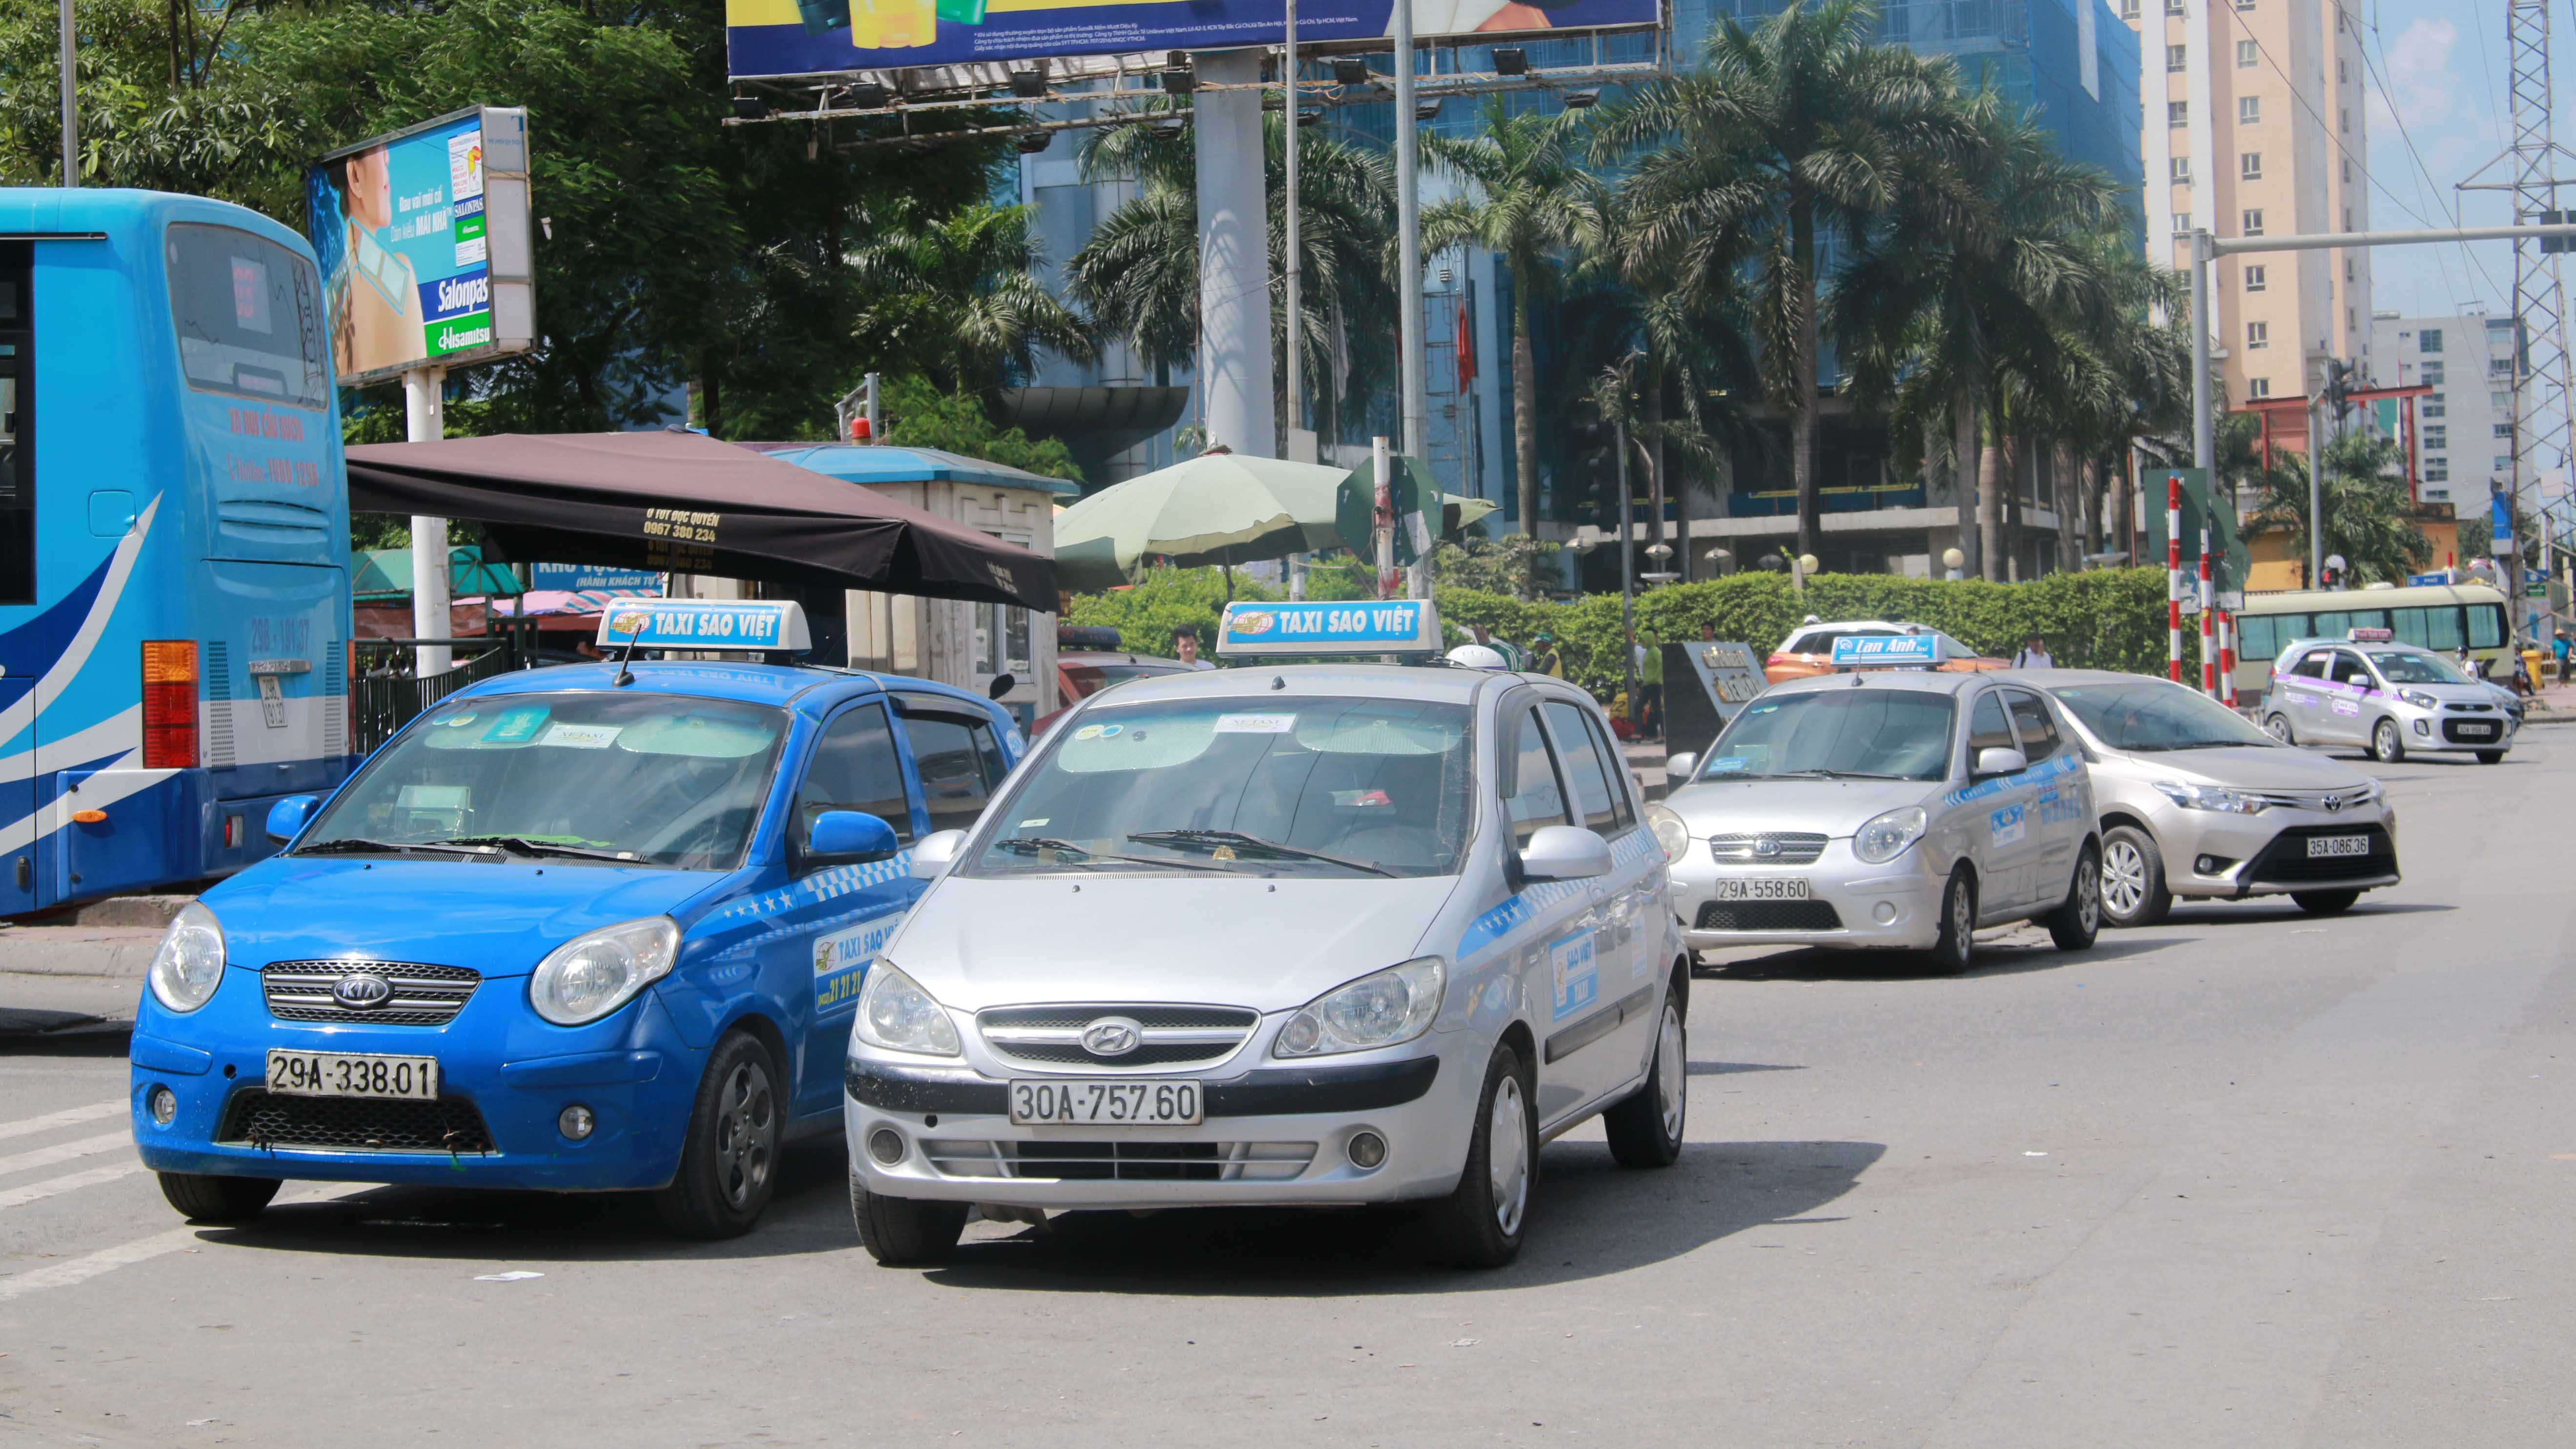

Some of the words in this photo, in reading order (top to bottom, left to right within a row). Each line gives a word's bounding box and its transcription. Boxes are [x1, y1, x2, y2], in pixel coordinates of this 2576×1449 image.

[399, 196, 411, 213] Đau
[412, 191, 421, 209] vai
[454, 197, 484, 218] SALONPAS
[416, 210, 431, 237] MÁI
[438, 276, 488, 312] Salonpas
[438, 327, 490, 350] Hisamitsu
[267, 458, 292, 485] 1900
[643, 521, 671, 536] 0967
[672, 524, 693, 539] 380
[694, 528, 716, 542] 234
[608, 575, 641, 586] KHÁCH
[655, 612, 693, 635] TAXI
[697, 613, 733, 636] SAO
[739, 610, 776, 641] VIỆT
[1279, 611, 1322, 633] TAXI
[1327, 610, 1366, 633] SAO
[1373, 605, 1414, 636] VIỆT
[1855, 639, 1883, 653] Lan
[1886, 638, 1916, 653] Anh
[2310, 838, 2367, 855] 35A-086.36
[1720, 880, 1806, 898] 29A-558.60
[838, 939, 860, 963] TAXI
[864, 933, 882, 955] SAO
[1566, 951, 1580, 972] SAO
[342, 981, 379, 999] KIA
[841, 974, 850, 999] 21
[851, 970, 861, 996] 21
[271, 1056, 429, 1096] 29A-338.01
[1015, 1084, 1196, 1121] 30A-757.60
